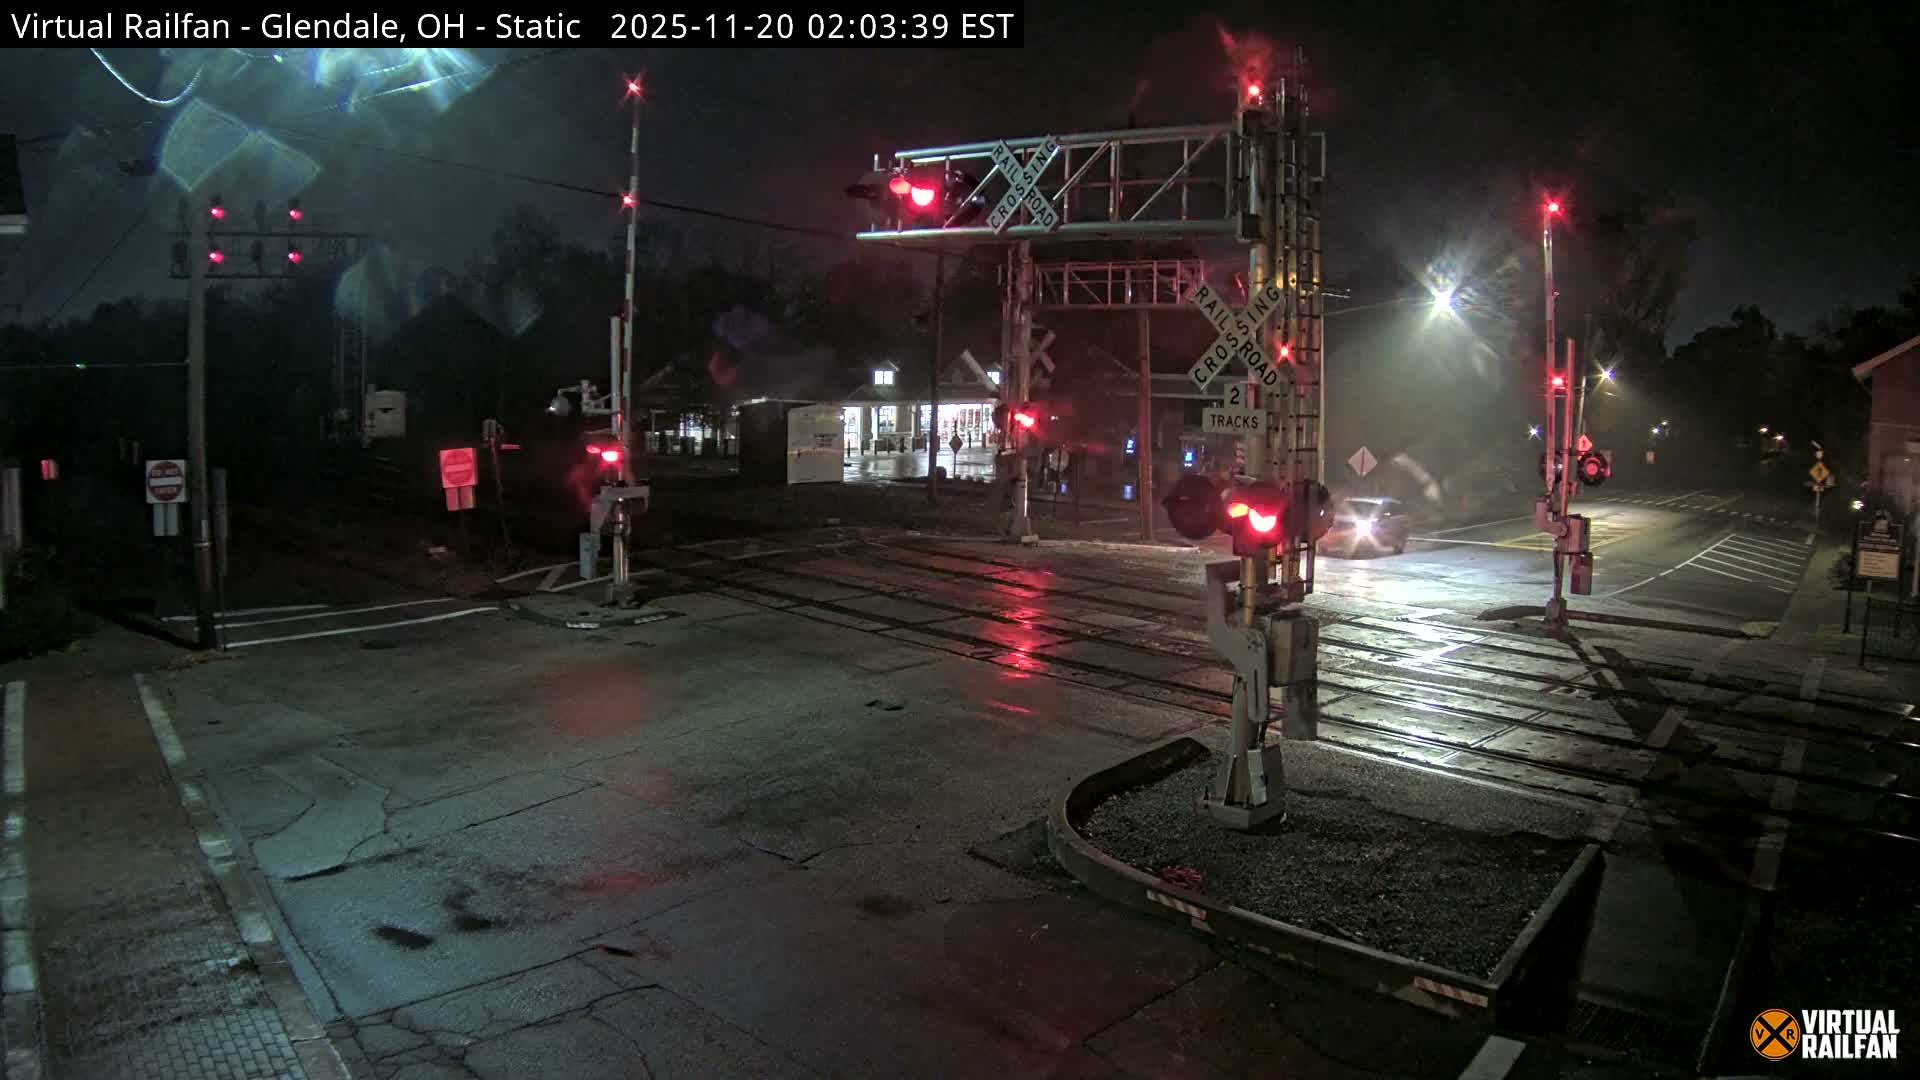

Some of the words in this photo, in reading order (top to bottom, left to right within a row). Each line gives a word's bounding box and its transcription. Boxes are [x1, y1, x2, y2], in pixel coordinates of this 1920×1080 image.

[990, 140, 1056, 229] CROSSING
[1194, 286, 1280, 384] CROSSING
[1210, 414, 1259, 429] TRACKS
[1230, 386, 1240, 404] 2
